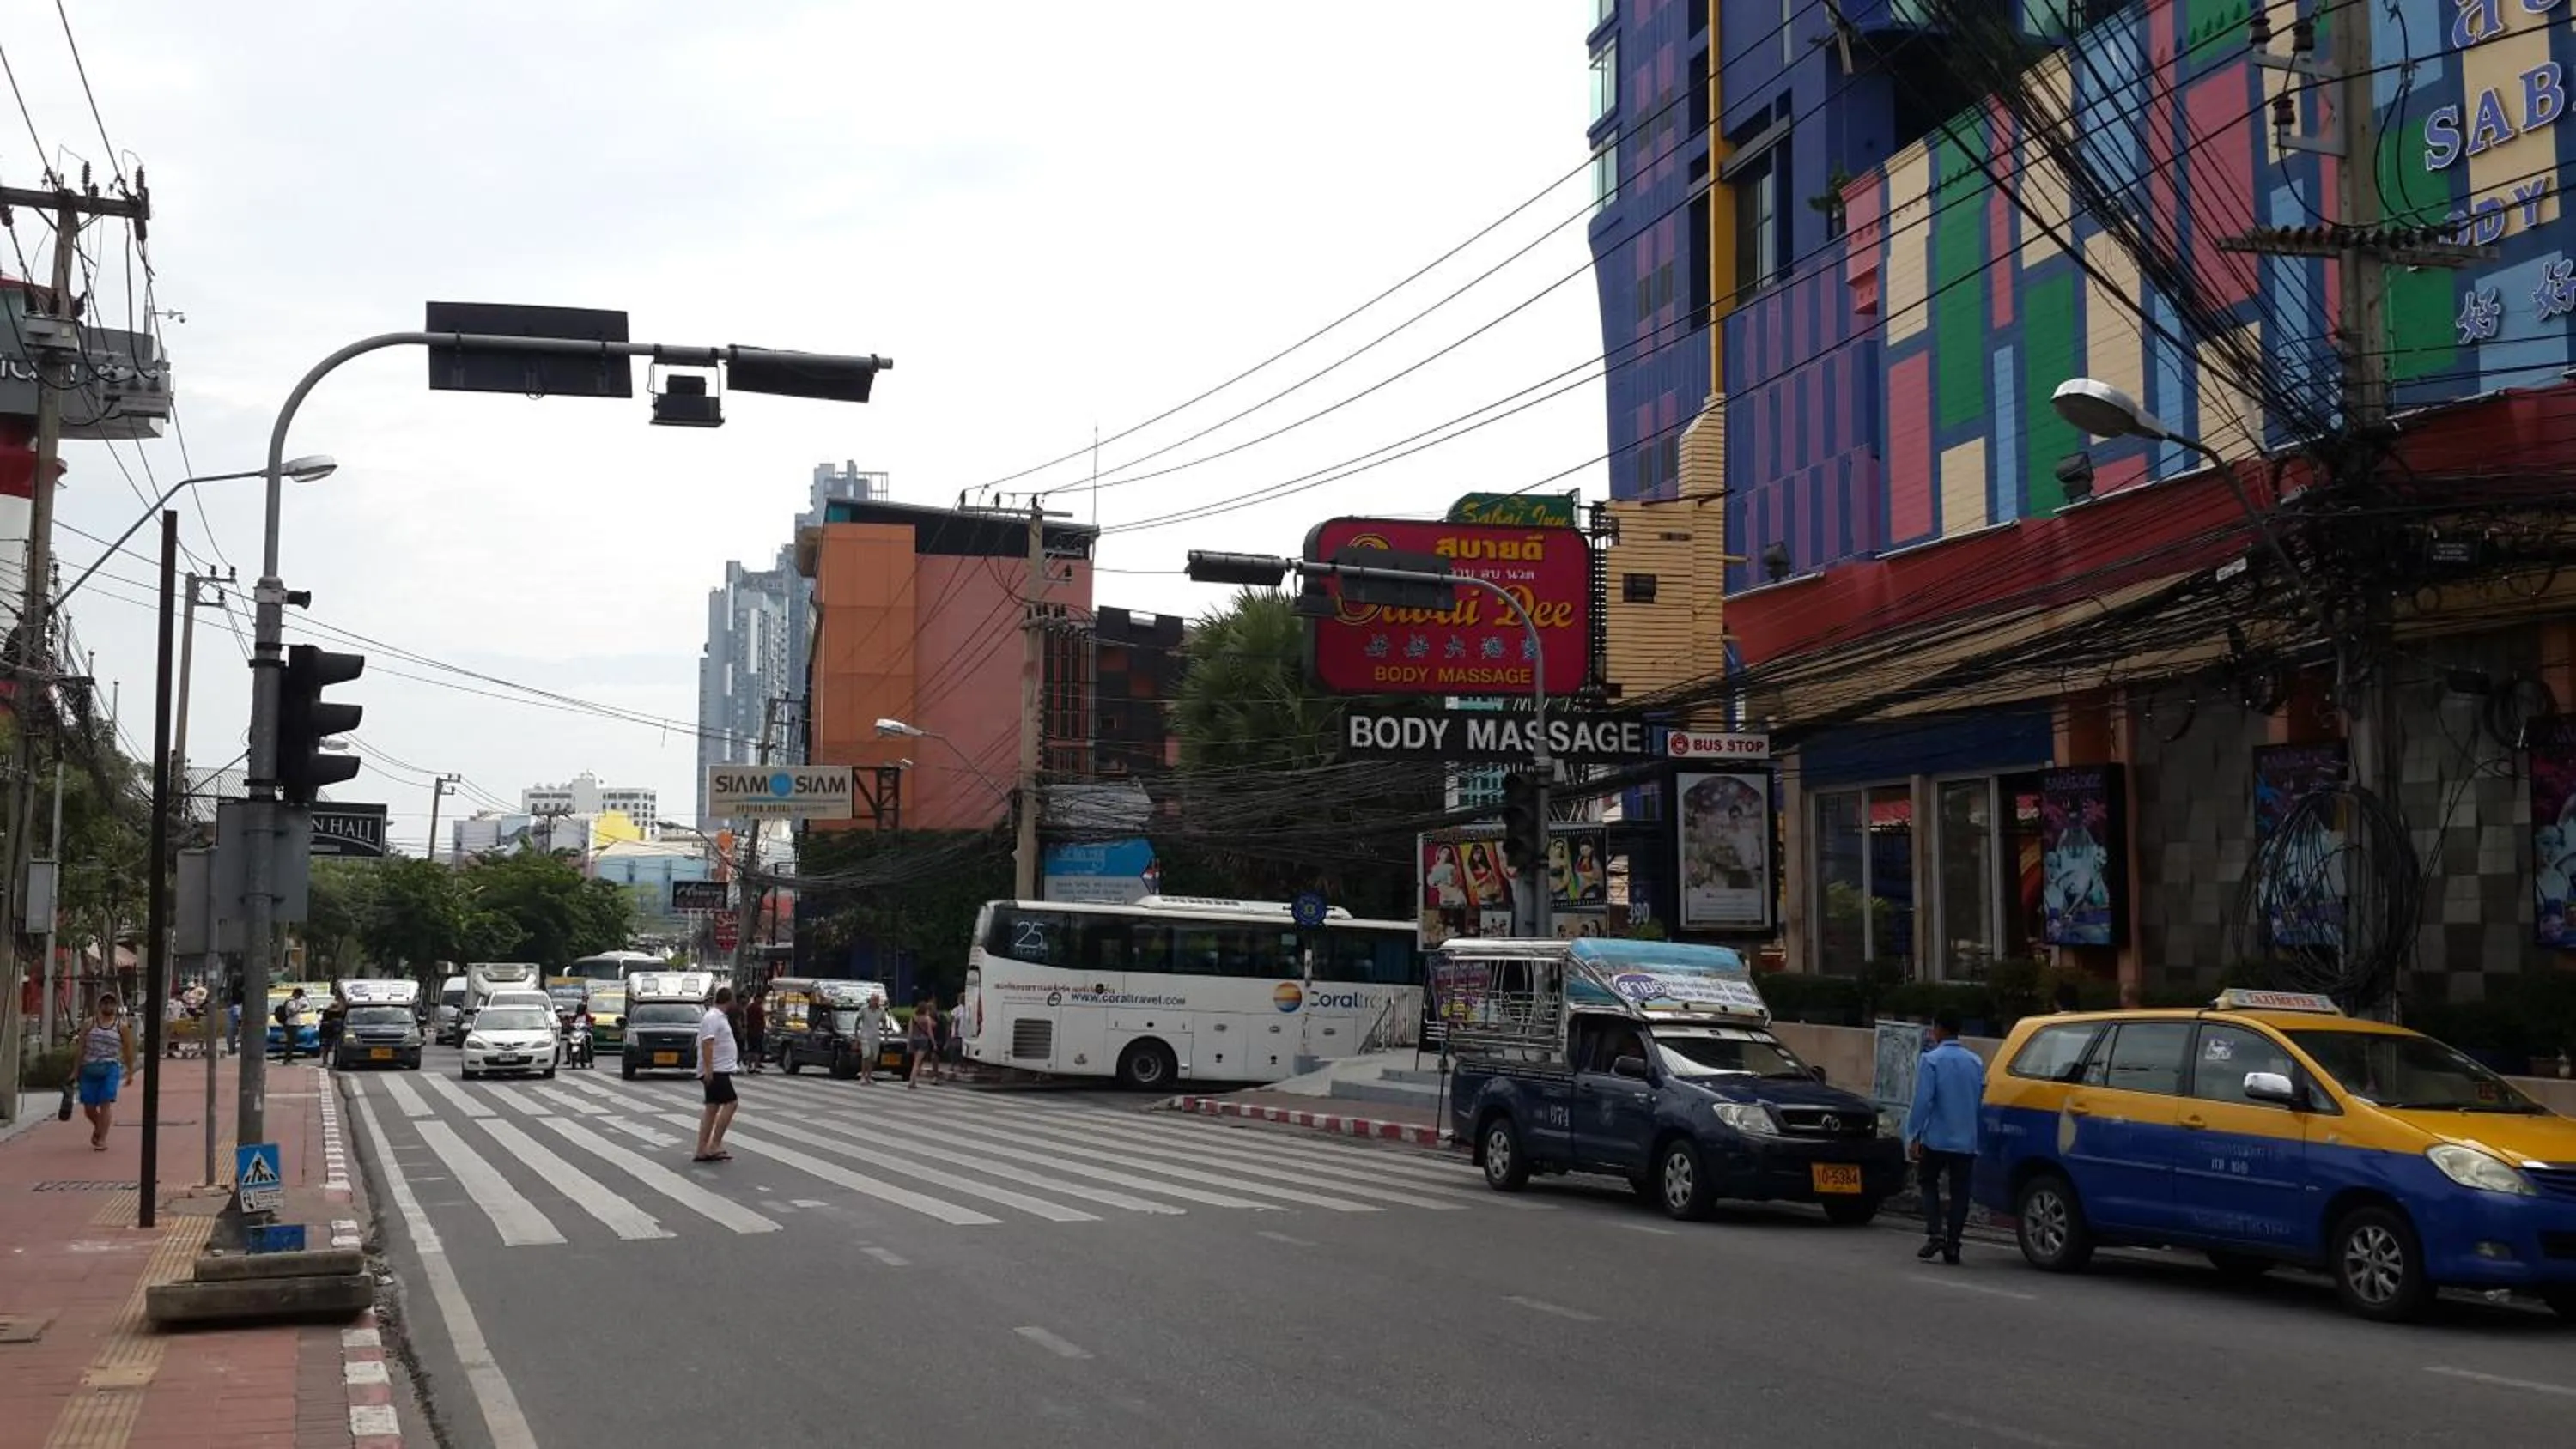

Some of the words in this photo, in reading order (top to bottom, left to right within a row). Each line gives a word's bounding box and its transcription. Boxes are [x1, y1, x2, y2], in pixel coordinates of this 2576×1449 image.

[2425, 61, 2576, 169] SAB
[1435, 533, 1546, 561] สบายดี
[1494, 584, 1576, 627] Dee
[1375, 666, 1430, 683] BODY
[1438, 667, 1533, 684] MASSAGE
[1349, 715, 1449, 751] BODY
[1467, 717, 1642, 754] MASSAGE
[1692, 737, 1722, 752] BUS
[1727, 738, 1765, 753] STOP
[715, 775, 768, 793] SIAM
[795, 775, 846, 793] SIAM
[330, 818, 376, 842] HALL
[1015, 920, 1045, 948] 25
